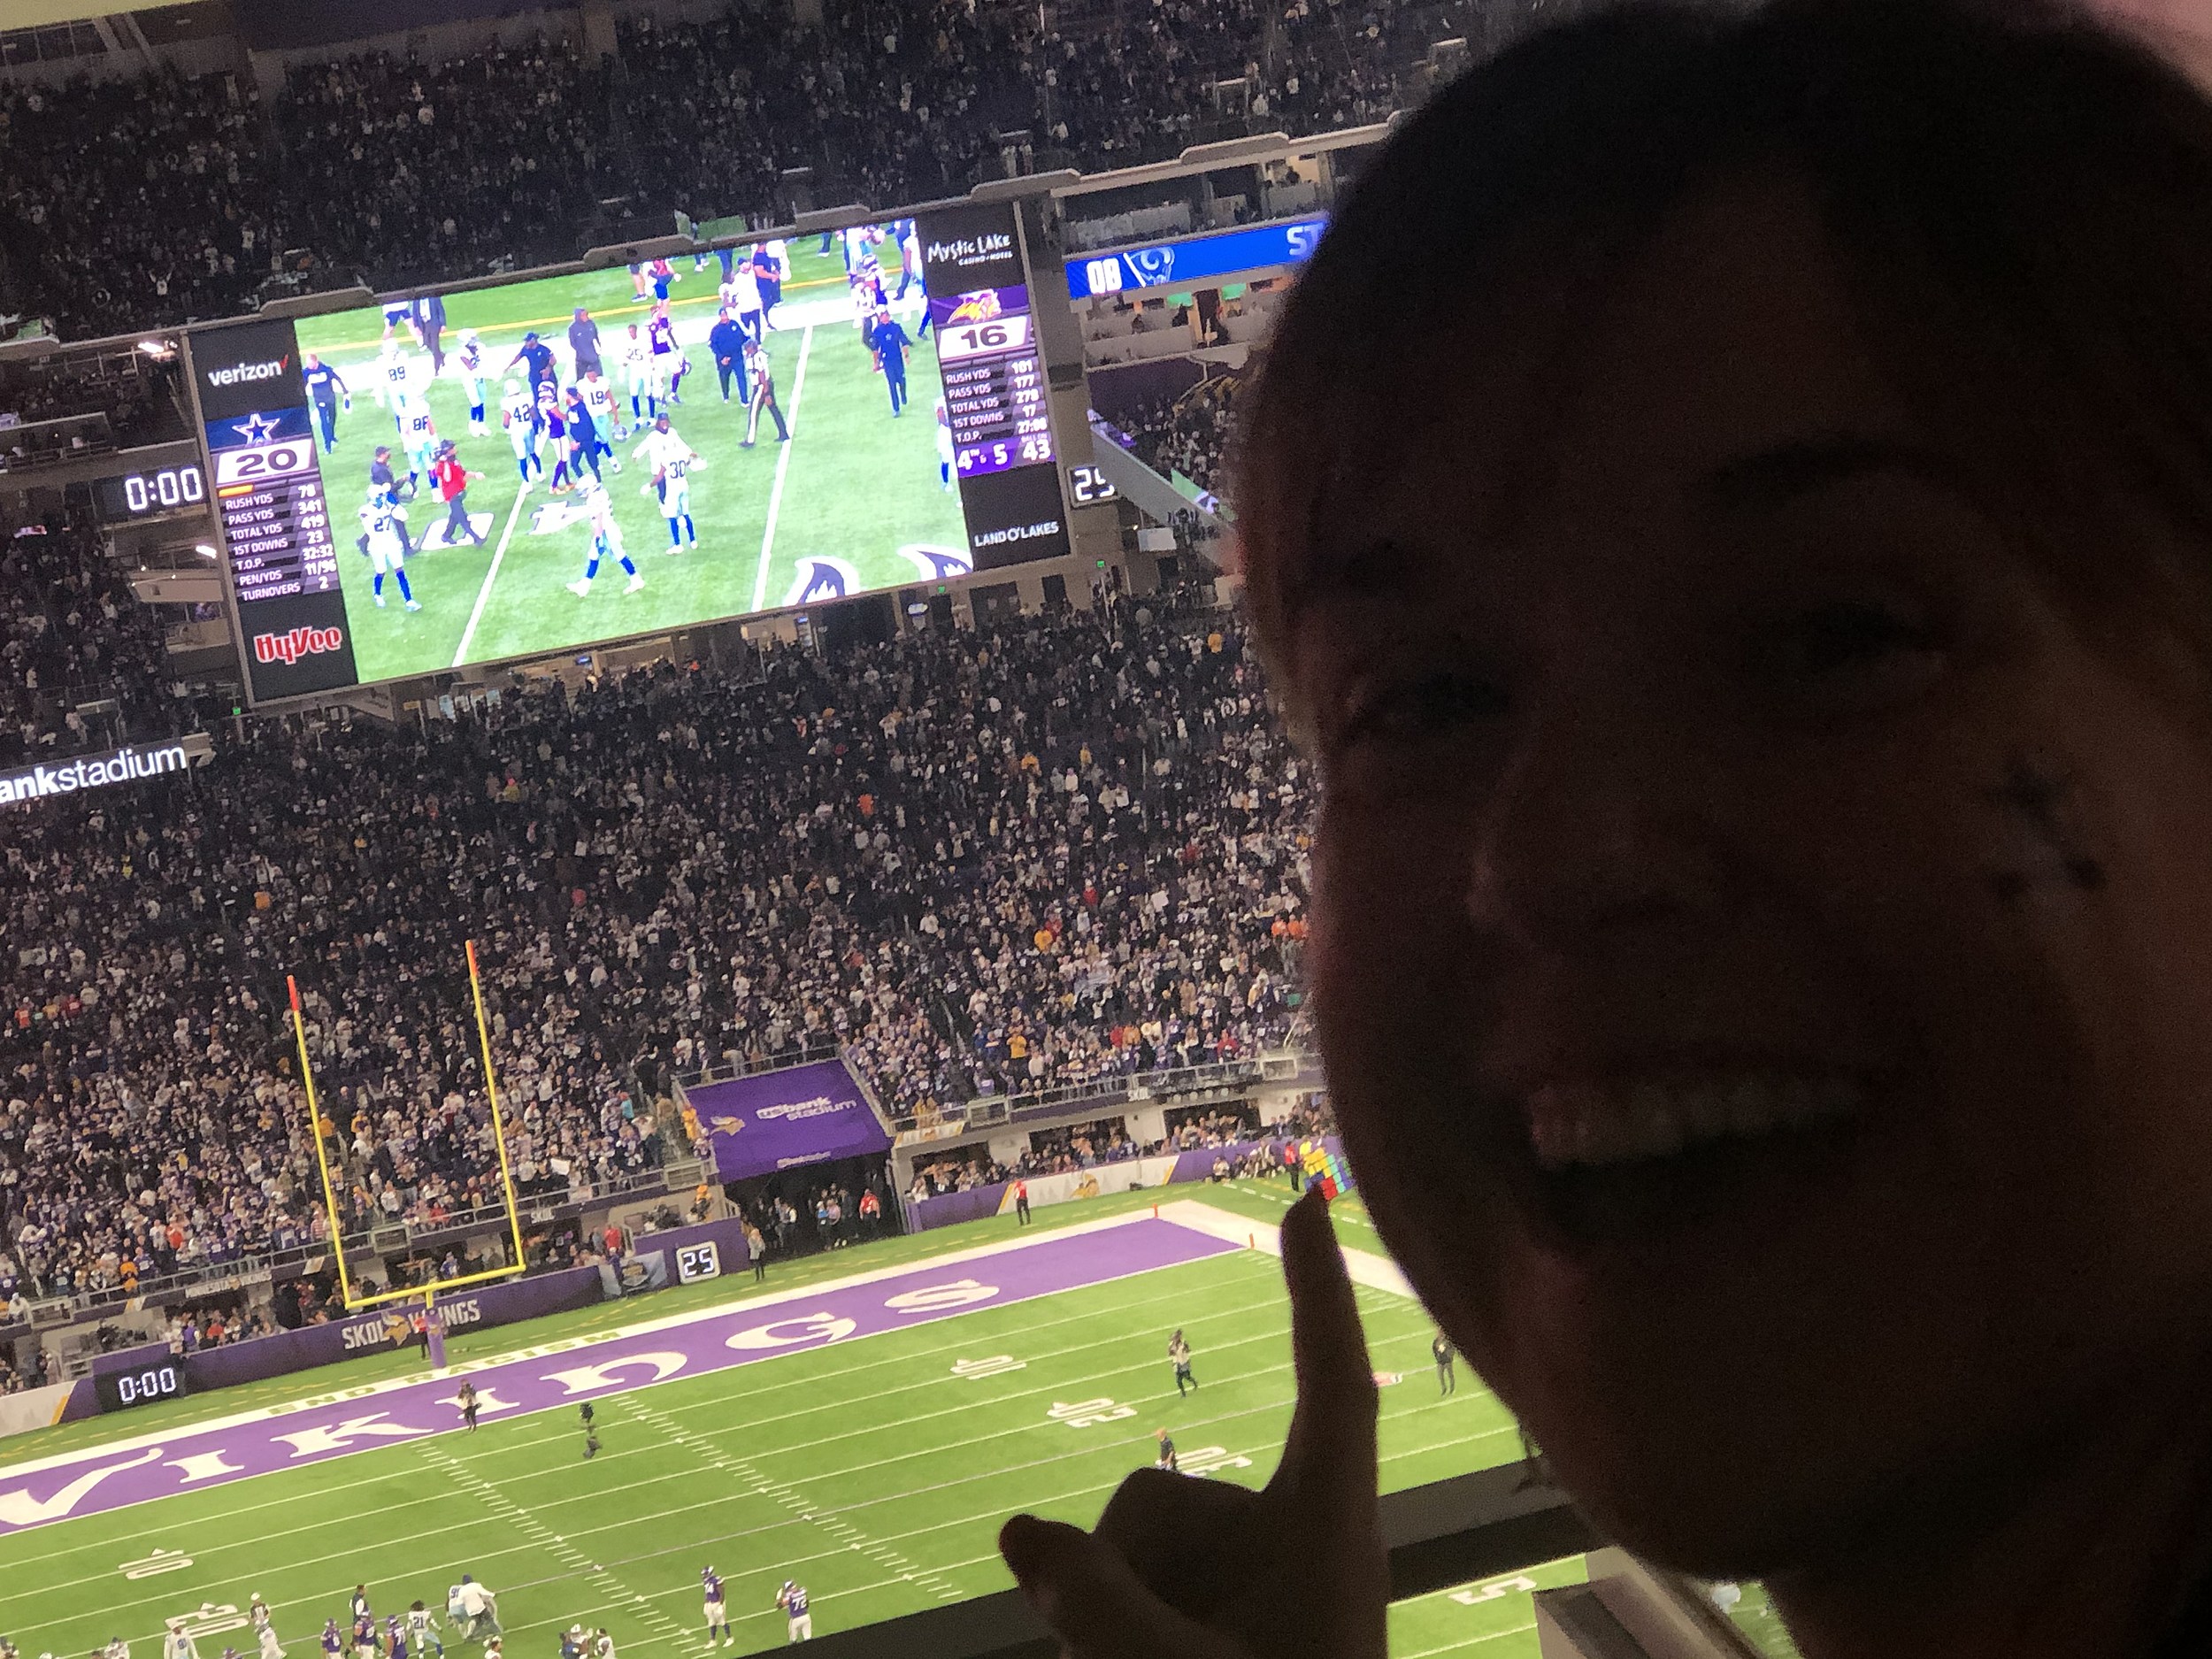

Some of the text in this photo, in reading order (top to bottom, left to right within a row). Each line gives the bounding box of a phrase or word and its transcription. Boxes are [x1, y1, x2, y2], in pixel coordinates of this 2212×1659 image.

[1286, 222, 1325, 257] ST
[961, 325, 1007, 349] 16
[208, 361, 281, 387] verizon
[388, 366, 405, 381] 89
[946, 371, 972, 384] RUSH
[972, 368, 991, 381] YDS
[590, 391, 605, 405] 19
[949, 374, 1034, 399] PASS YDS 177
[513, 403, 531, 422] 42
[951, 401, 980, 413] TOTAL
[980, 397, 999, 408] YDS
[953, 403, 1036, 428] 1ST DOWNS 17
[993, 443, 1008, 465] 5
[1023, 439, 1050, 461] 43
[235, 449, 297, 477] 20
[669, 460, 686, 479] 30
[125, 467, 203, 511] 0:00
[226, 496, 254, 511] RUSH
[254, 493, 273, 506] YDS
[228, 499, 321, 526] PASS YDS 341
[230, 514, 325, 541] TOTAL YDS 419
[974, 530, 1007, 547] LAND
[233, 530, 324, 556] 1ST DOWNS 23
[236, 544, 334, 571] T.O.P. 32:32
[239, 570, 282, 586] PEN/YDS
[242, 576, 329, 601] TURNOVERS 2
[682, 1248, 714, 1276] 25
[342, 1319, 390, 1349] SKOL
[119, 1367, 176, 1402] 0:00
[268, 1330, 620, 1417] END RACISM
[413, 1616, 425, 1629] 21
